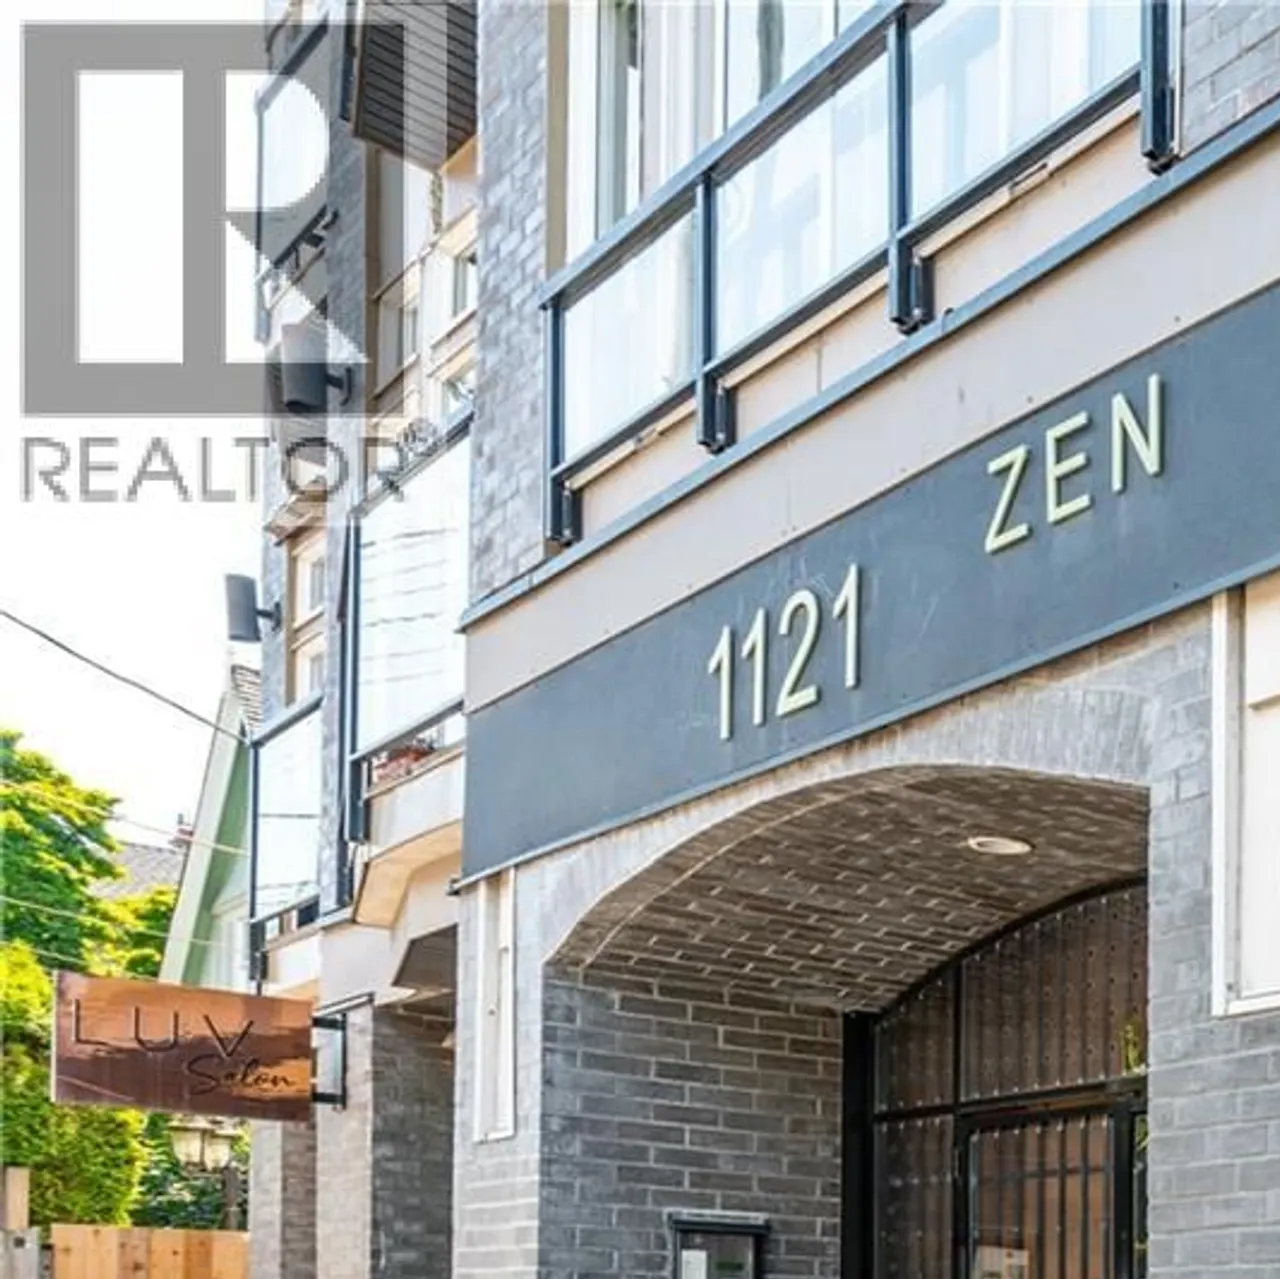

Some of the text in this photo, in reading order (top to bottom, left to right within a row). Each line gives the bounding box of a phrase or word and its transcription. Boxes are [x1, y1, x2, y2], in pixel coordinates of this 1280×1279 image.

[708, 373, 1163, 740] 1121 ZEN
[73, 998, 254, 1058] LUV
[185, 1053, 297, 1096] Salon
